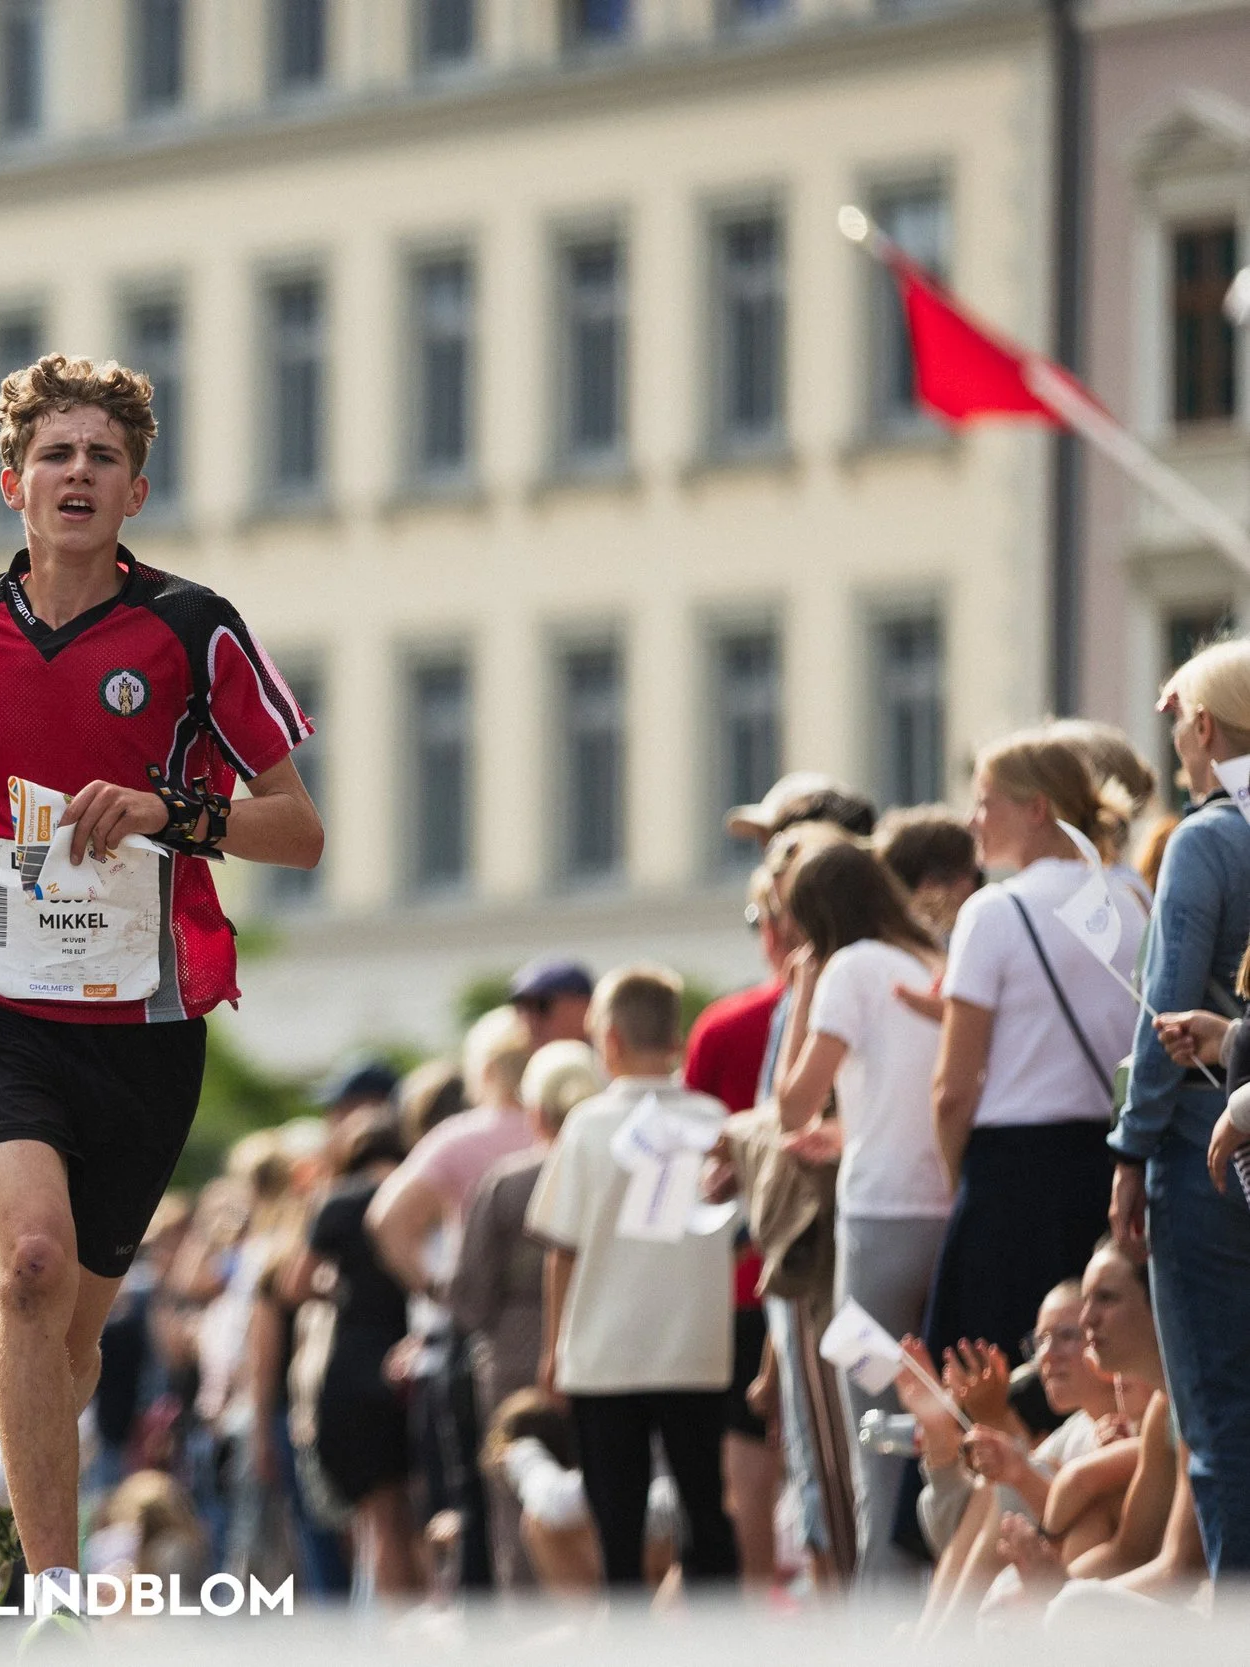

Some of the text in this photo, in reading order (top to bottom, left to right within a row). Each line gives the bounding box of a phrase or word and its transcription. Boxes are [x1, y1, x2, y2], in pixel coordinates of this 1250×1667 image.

[9, 581, 36, 625] noname
[39, 913, 108, 929] MIKKEL
[29, 983, 74, 992] CHALMERS
